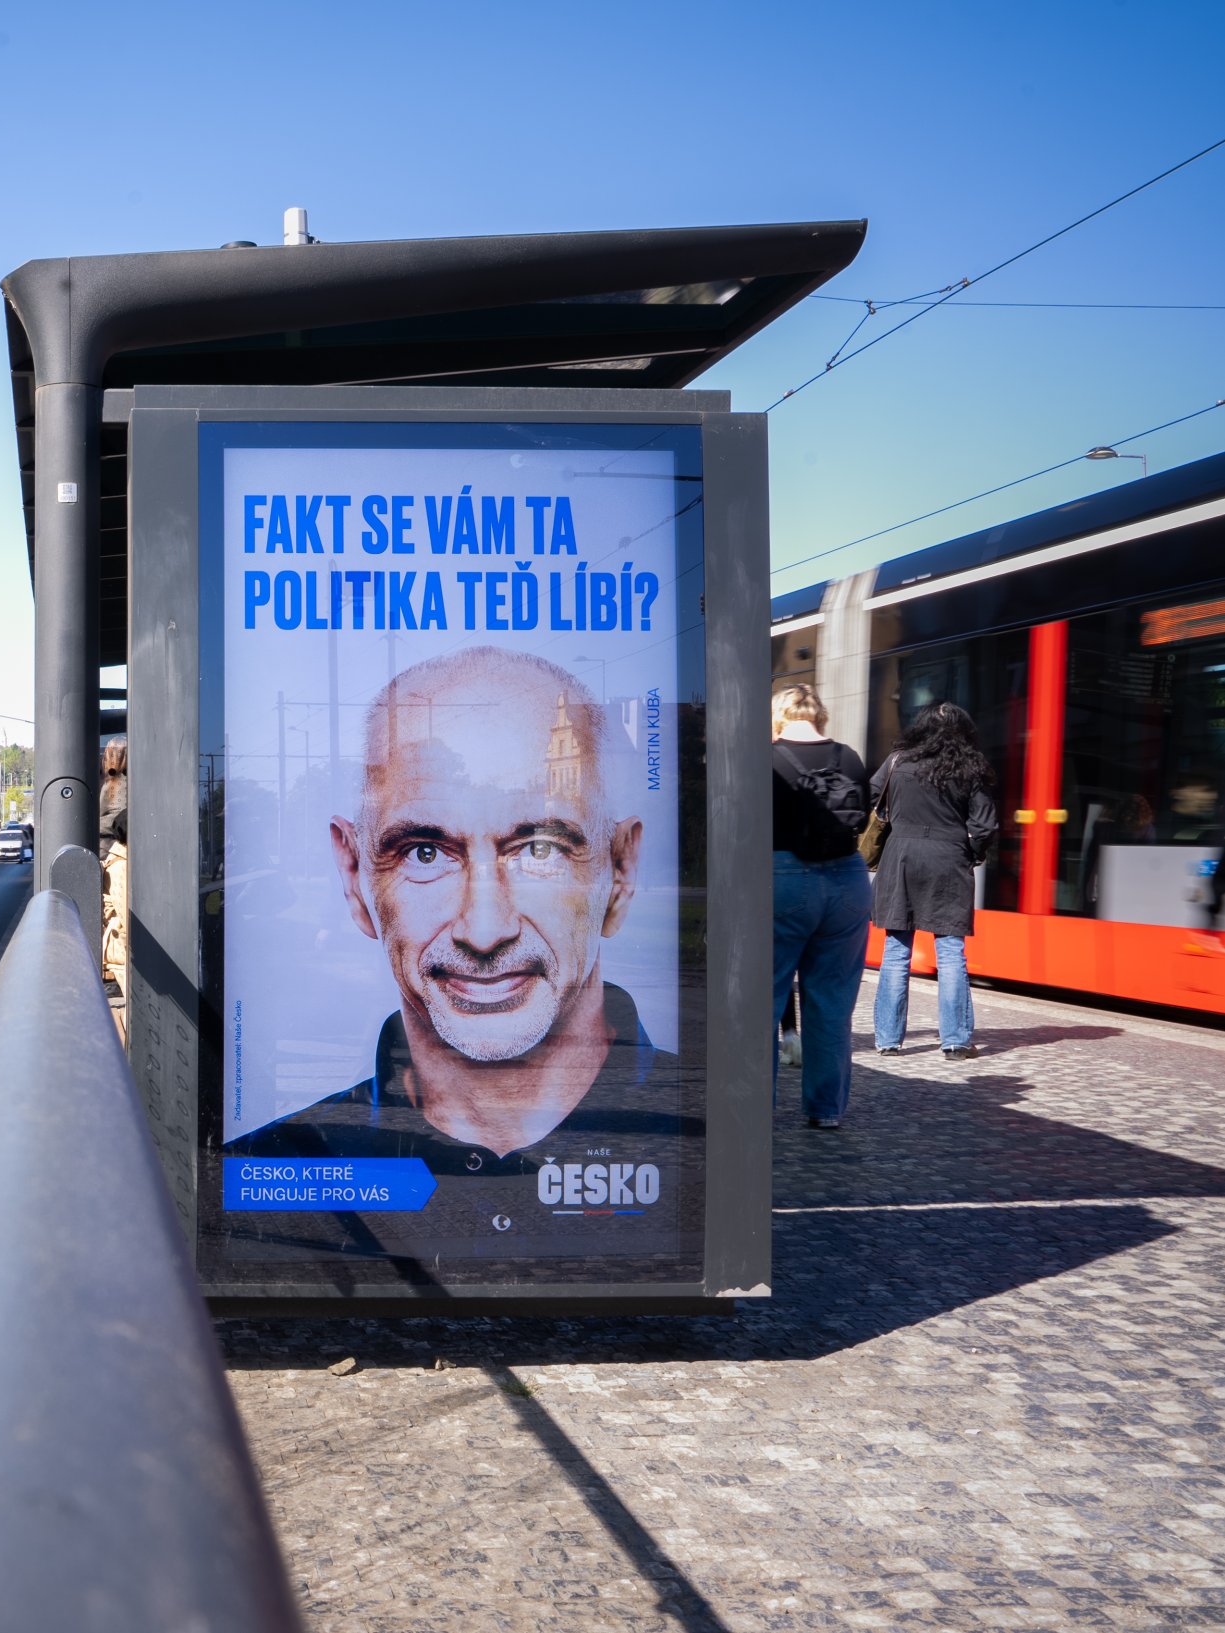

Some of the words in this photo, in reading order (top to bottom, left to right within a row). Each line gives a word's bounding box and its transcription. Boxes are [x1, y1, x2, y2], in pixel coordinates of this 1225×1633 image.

[244, 495, 351, 554] FAKT
[361, 495, 416, 555] SE
[425, 485, 516, 555] VÁM
[526, 496, 578, 555] TA
[244, 570, 448, 630] POLITIKA
[457, 561, 538, 631] TEĎ
[550, 561, 660, 632] LÍBÍ?
[647, 688, 660, 728] KUBA
[647, 733, 660, 790] MARTIN
[233, 1000, 242, 1021] Česko
[234, 1023, 242, 1042] Naše
[234, 1086, 243, 1121] Zadavatel,
[587, 1148, 611, 1156] NAŠE
[241, 1163, 299, 1183] ČESKO,
[302, 1164, 354, 1181] KTERÉ
[538, 1157, 660, 1205] ČESKO
[241, 1187, 318, 1201] FUNGUJE
[322, 1188, 356, 1201] PRO
[359, 1184, 390, 1202] VÁS
